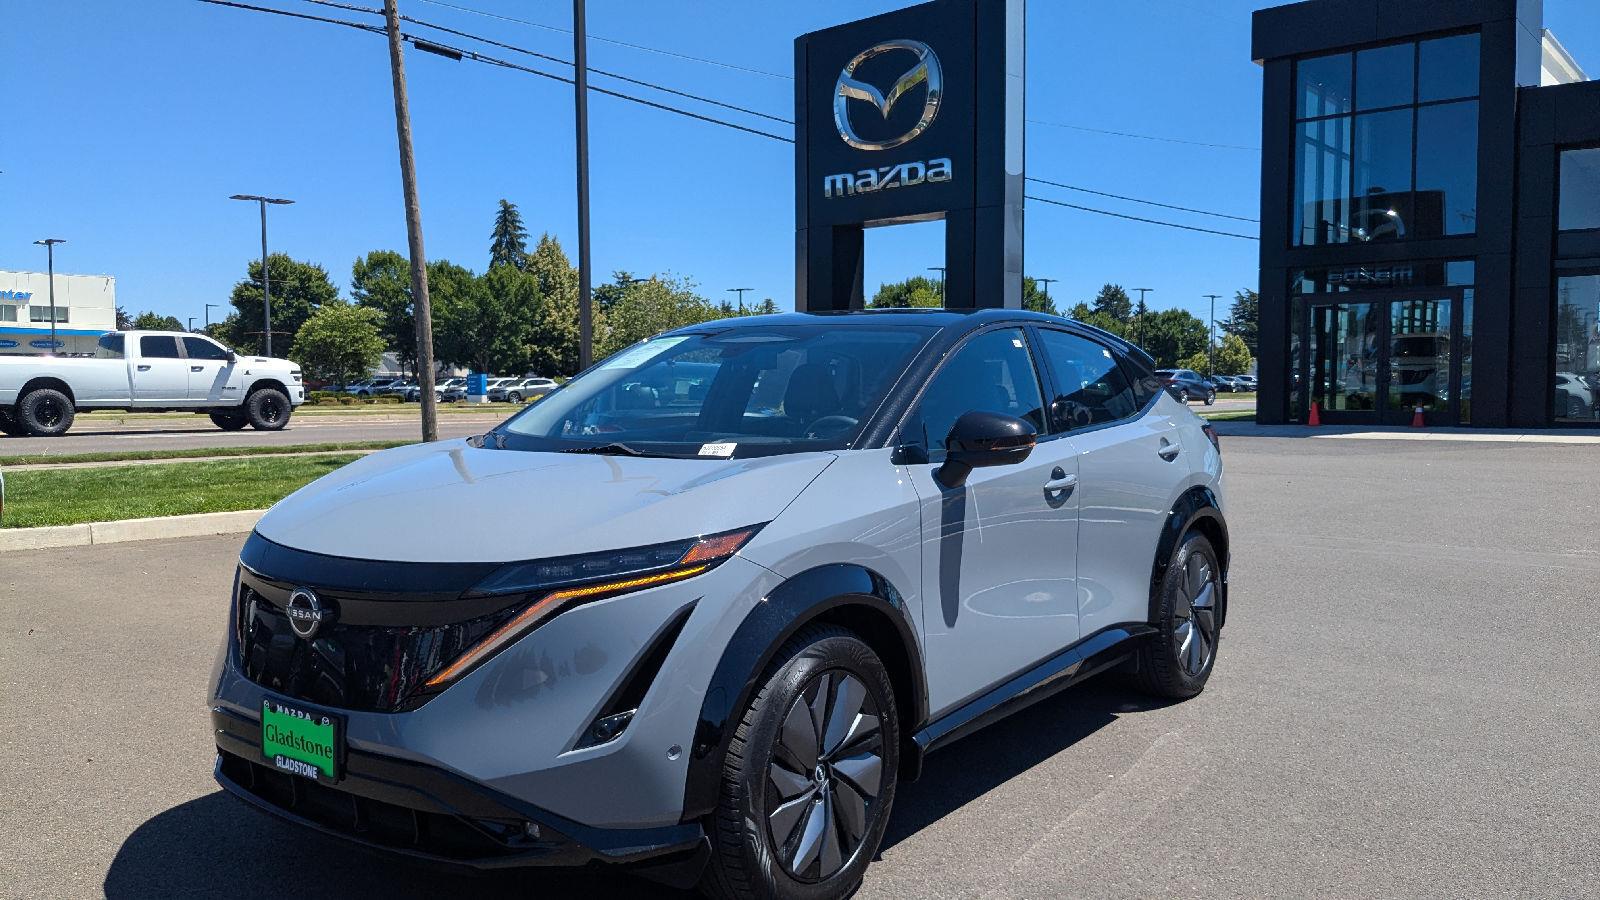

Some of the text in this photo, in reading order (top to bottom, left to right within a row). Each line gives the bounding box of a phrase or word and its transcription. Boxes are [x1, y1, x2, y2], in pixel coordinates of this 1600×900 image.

[824, 157, 953, 198] mazda
[276, 704, 311, 720] MAZDA
[265, 723, 333, 760] Gladstone
[276, 755, 318, 779] GLADSTONE
